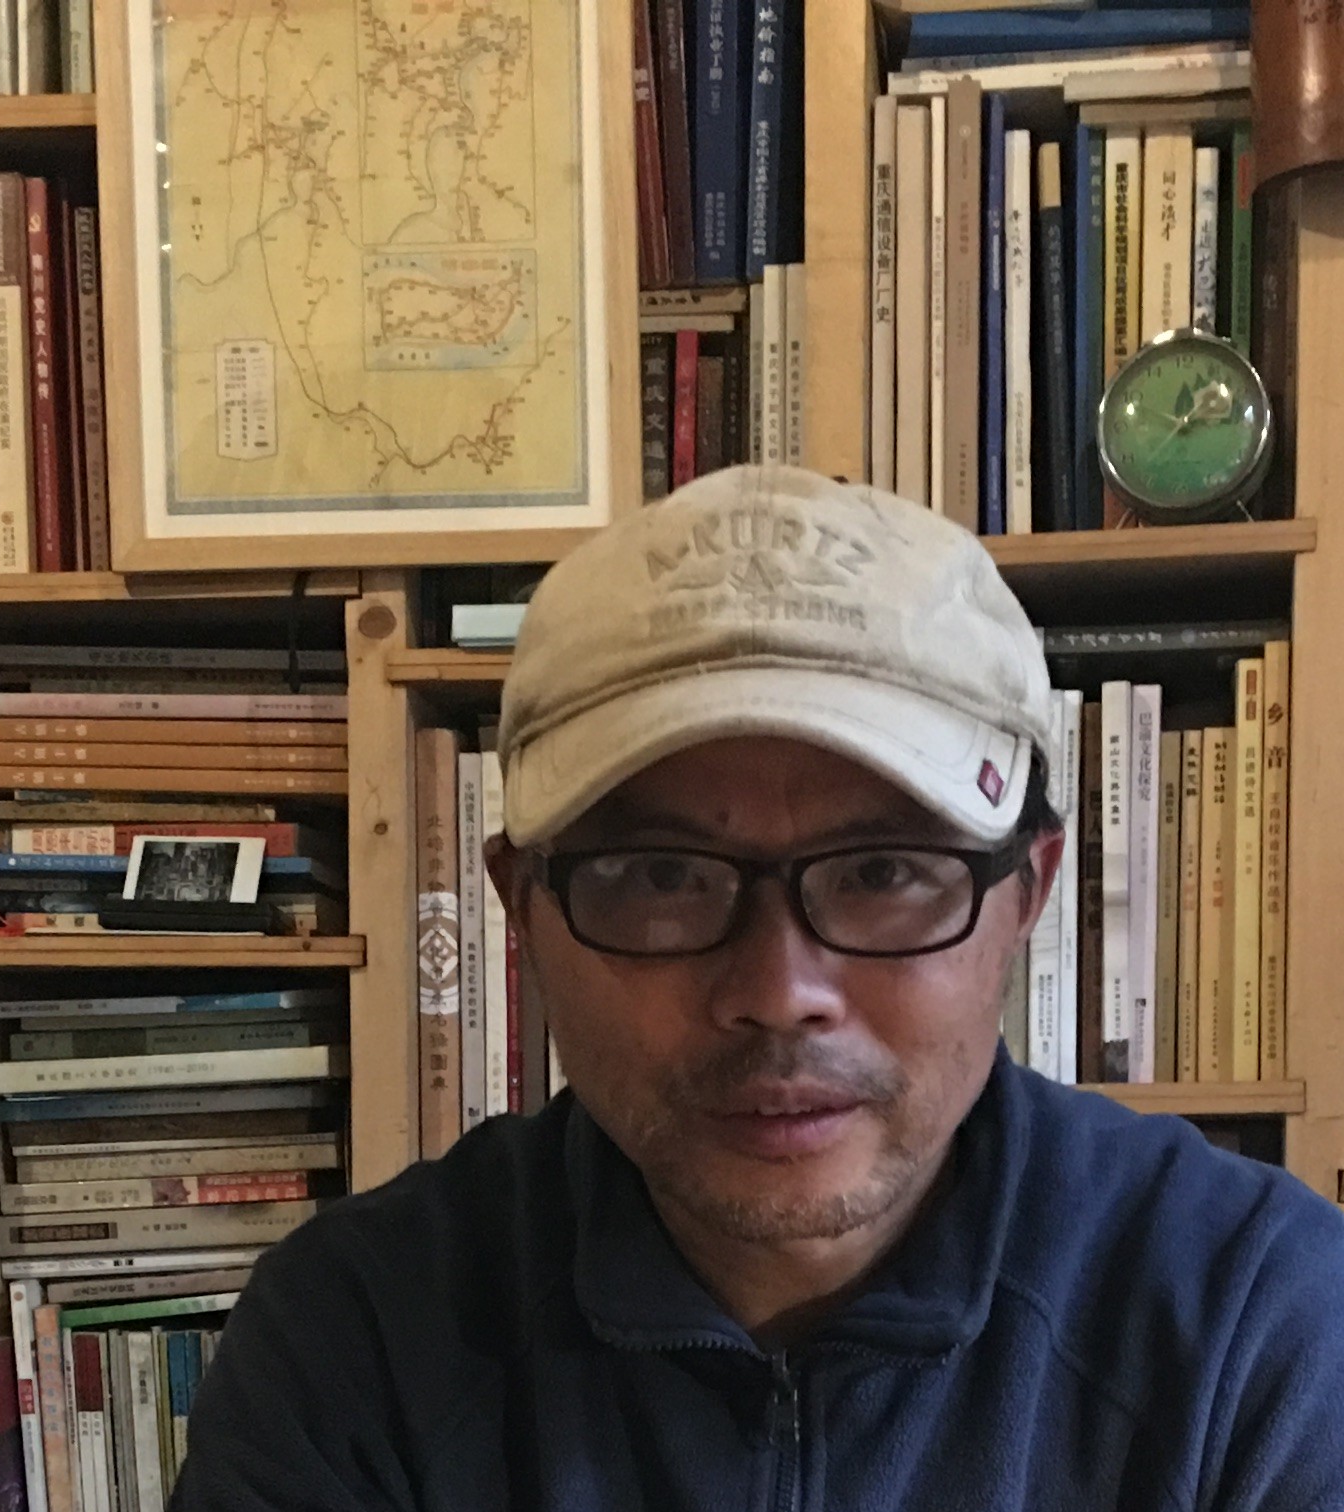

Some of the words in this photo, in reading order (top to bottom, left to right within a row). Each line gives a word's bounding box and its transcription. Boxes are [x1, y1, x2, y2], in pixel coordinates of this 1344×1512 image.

[874, 163, 892, 325] 重庆通信设备厂厂史
[1267, 702, 1286, 770] 乡音
